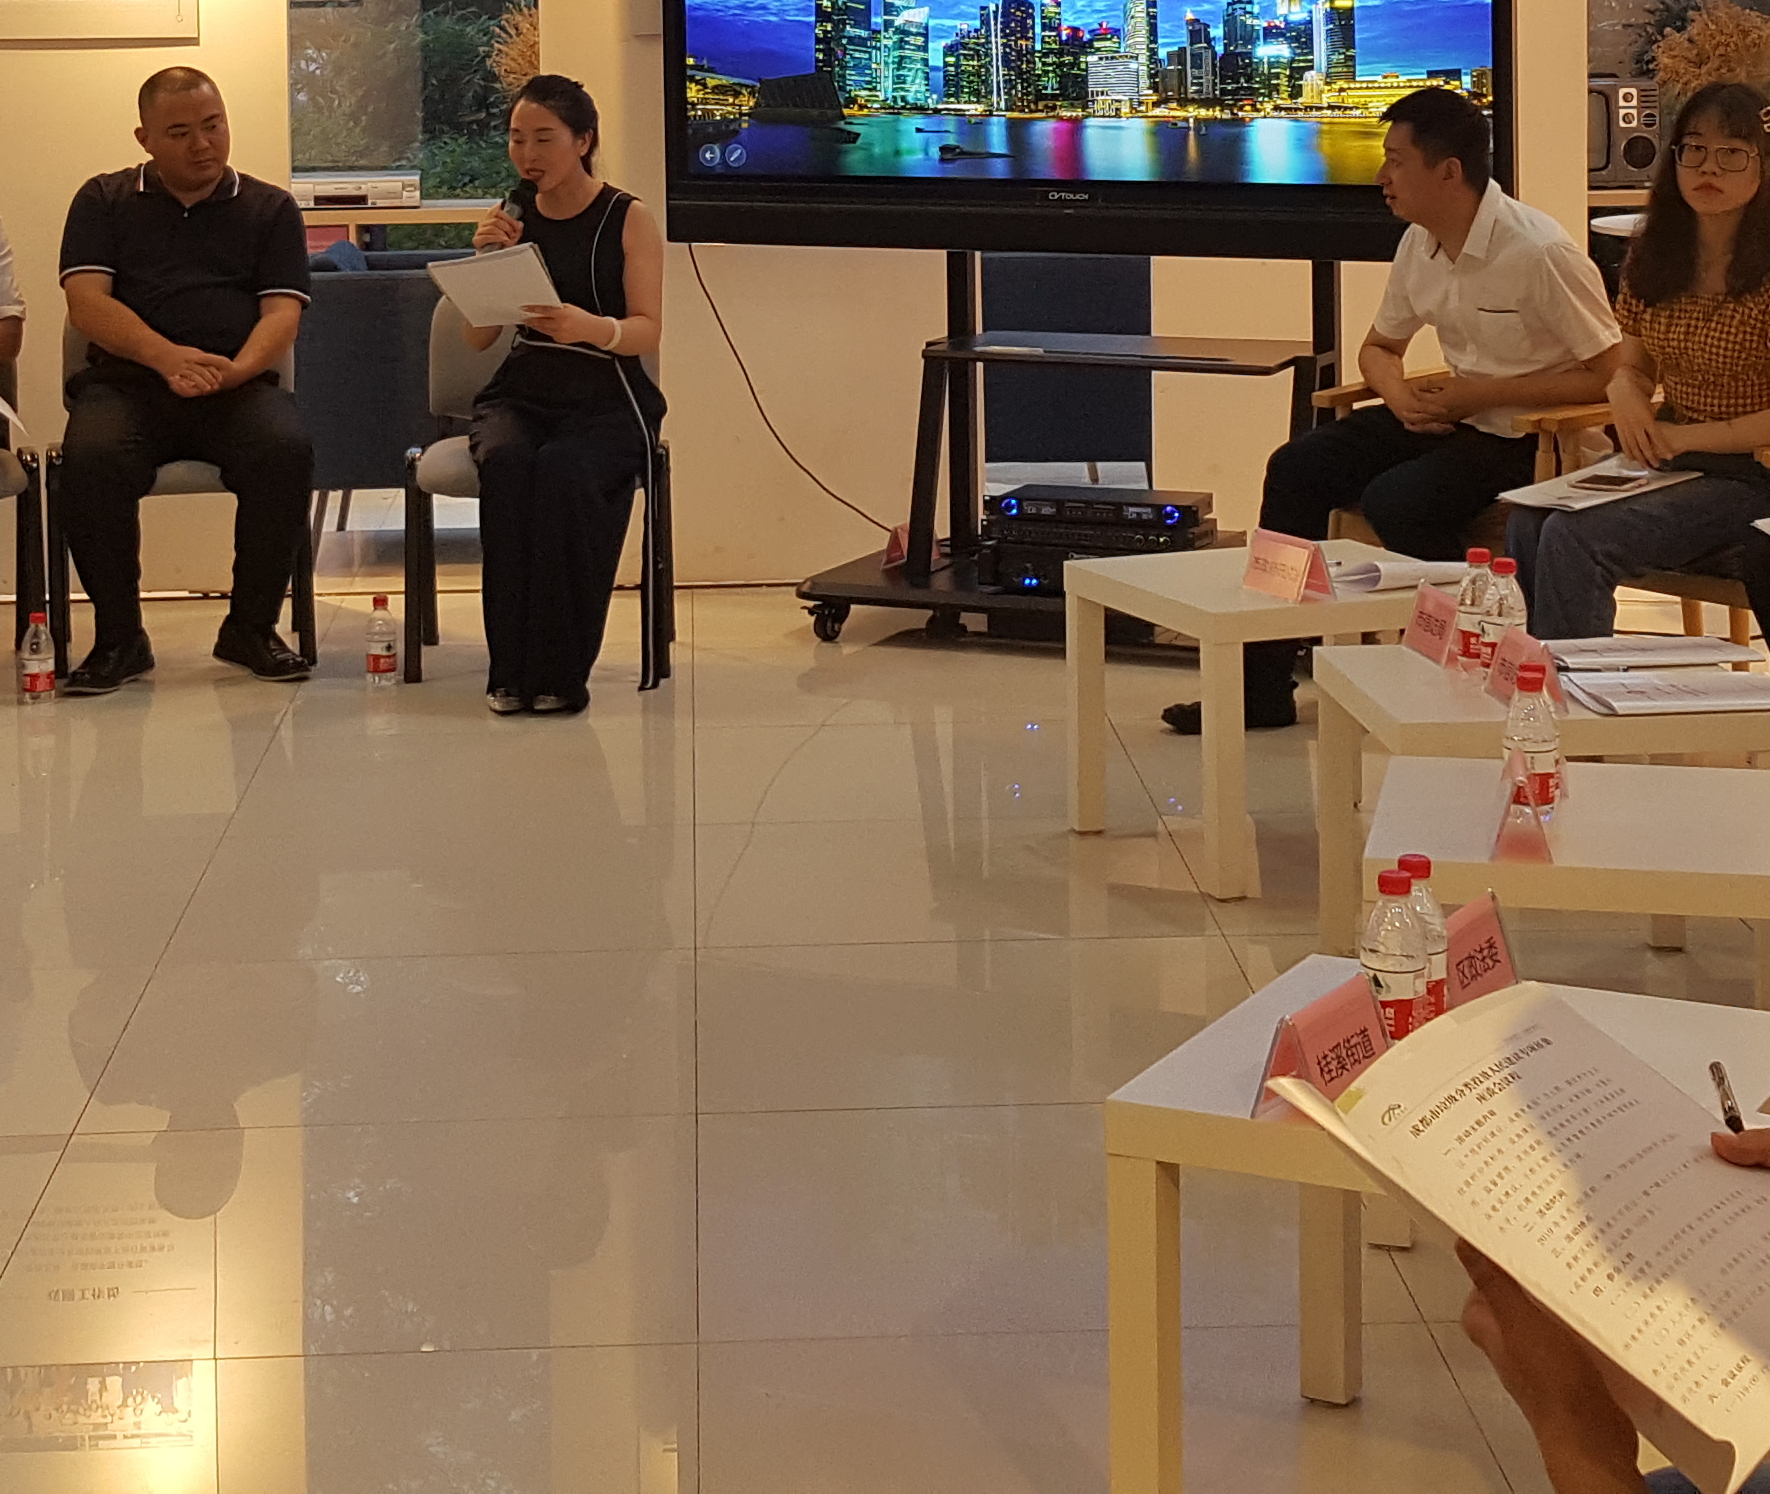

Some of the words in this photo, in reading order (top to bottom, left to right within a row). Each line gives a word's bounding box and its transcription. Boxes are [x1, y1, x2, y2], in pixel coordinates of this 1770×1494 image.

[1455, 936, 1502, 991] 区政法委
[1316, 1025, 1376, 1087] 桂溪街道
